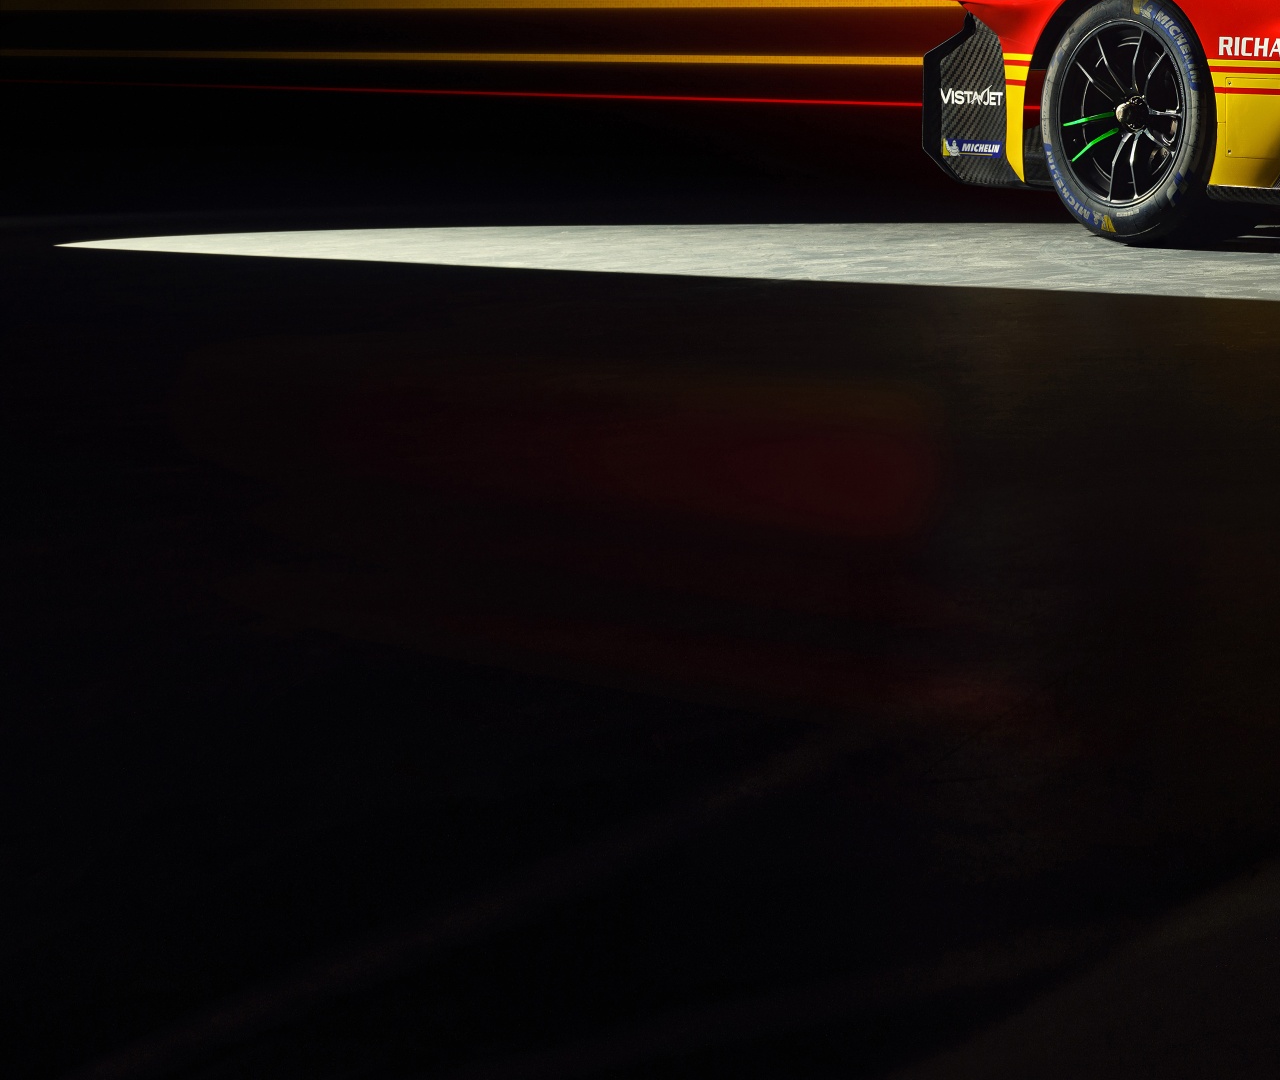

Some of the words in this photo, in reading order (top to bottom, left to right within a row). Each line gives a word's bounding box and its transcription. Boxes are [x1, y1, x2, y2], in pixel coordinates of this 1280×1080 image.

[1153, 9, 1201, 84] MICHELIN
[962, 142, 1001, 153] MICHELIN
[1046, 150, 1091, 221] MICHELIN
